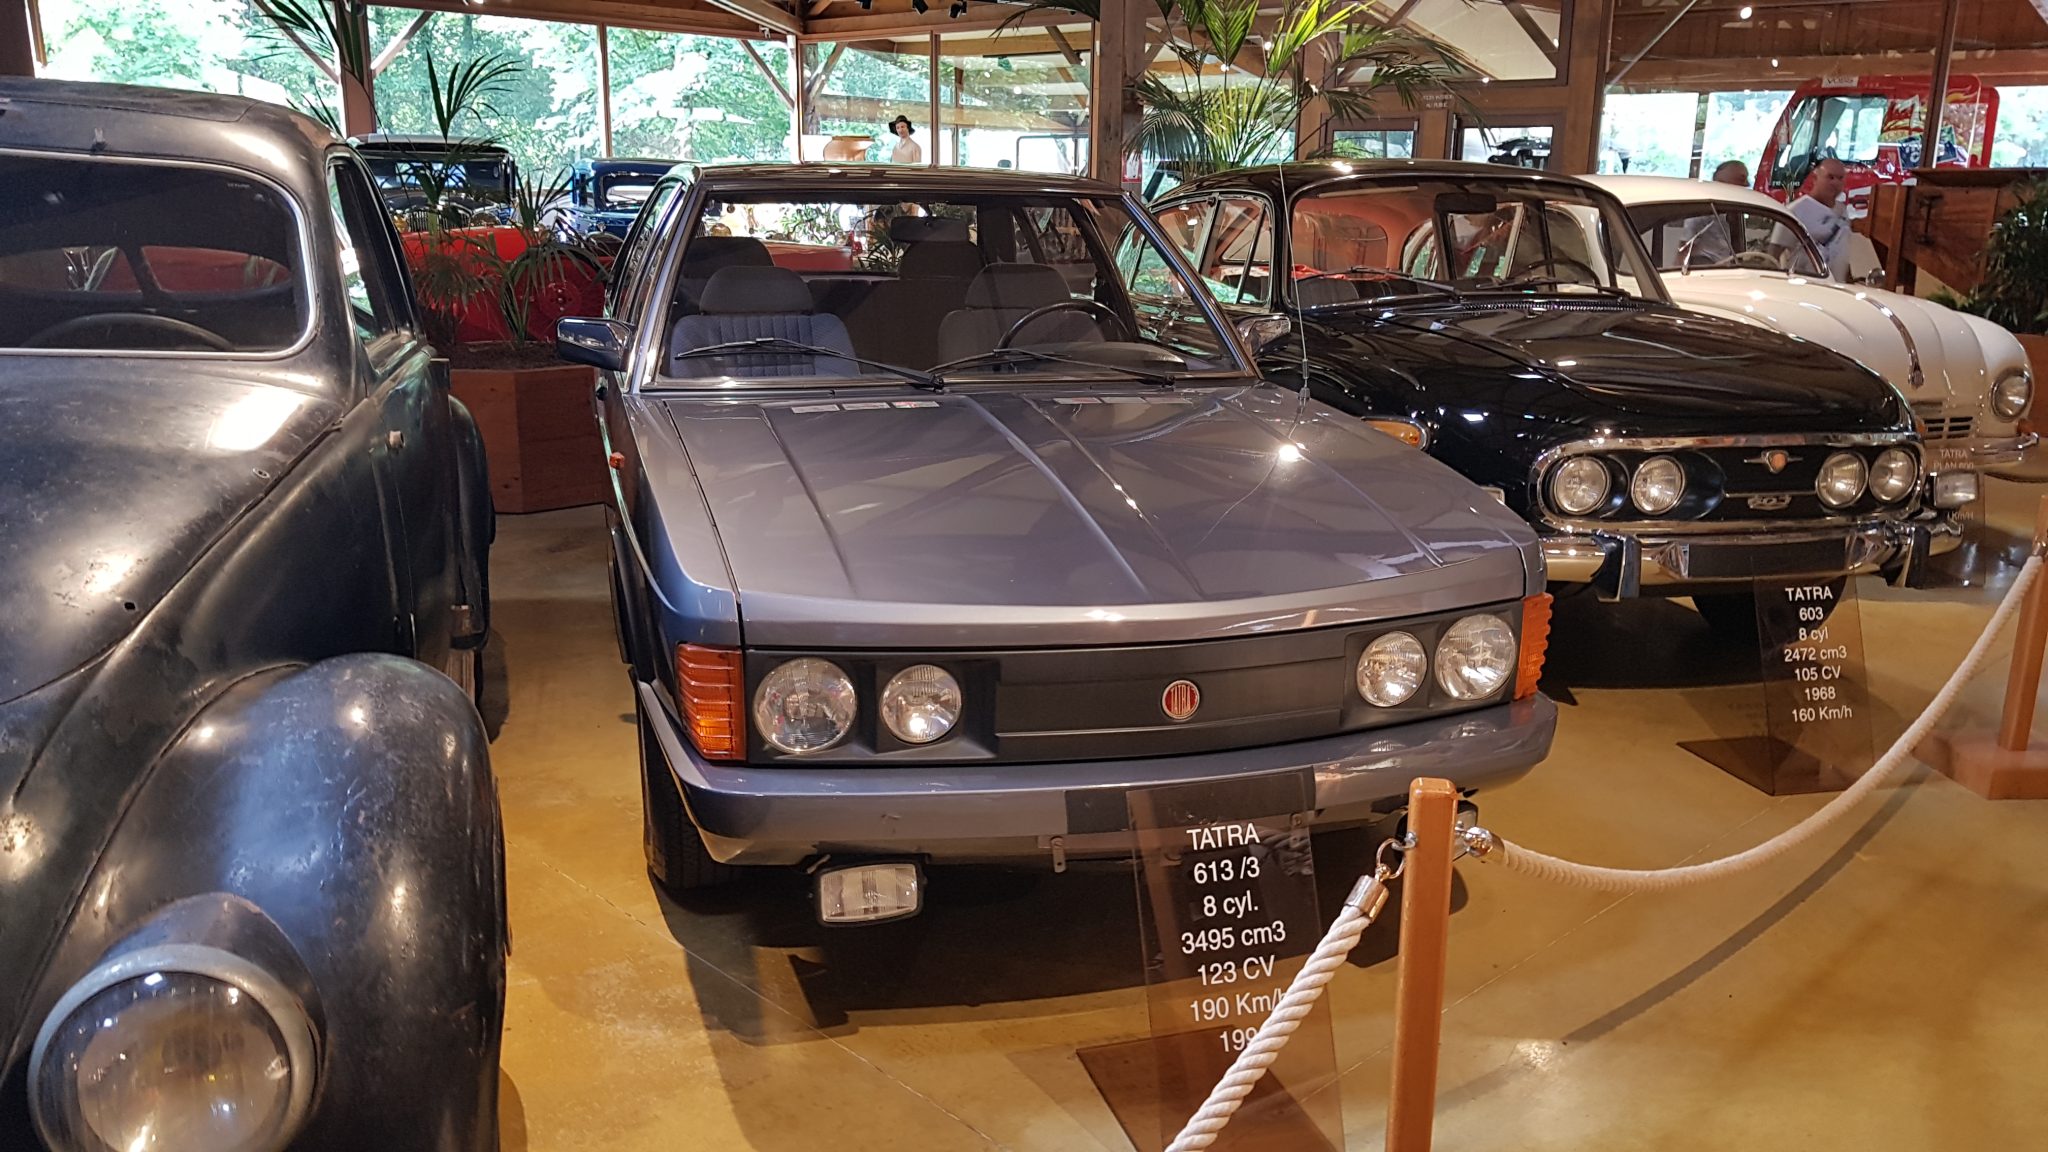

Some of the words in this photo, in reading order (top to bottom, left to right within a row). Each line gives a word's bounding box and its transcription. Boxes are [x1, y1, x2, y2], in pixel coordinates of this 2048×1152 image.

[1940, 448, 1967, 458] TATRA
[1785, 586, 1833, 601] TATRA
[1799, 607, 1824, 621] 603
[1799, 628, 1807, 641] 8
[1810, 627, 1829, 642] cyl
[1784, 648, 1817, 662] 2472
[1820, 646, 1847, 660] cm3
[1795, 668, 1818, 681] 105
[1822, 666, 1841, 680] CV
[1804, 687, 1836, 701] 1968
[1792, 709, 1816, 722] 160
[1819, 706, 1852, 721] Km/h
[1186, 823, 1261, 850] TATRA
[1194, 859, 1234, 884] 613
[1240, 856, 1260, 879] /3
[1203, 895, 1217, 917] 8
[1223, 890, 1259, 918] cyl.
[1181, 927, 1235, 954] 3495
[1241, 920, 1286, 946] cm3
[1198, 961, 1237, 985] 123
[1243, 955, 1275, 979] CV
[1190, 997, 1229, 1021] 190
[1220, 1027, 1258, 1052] 199
